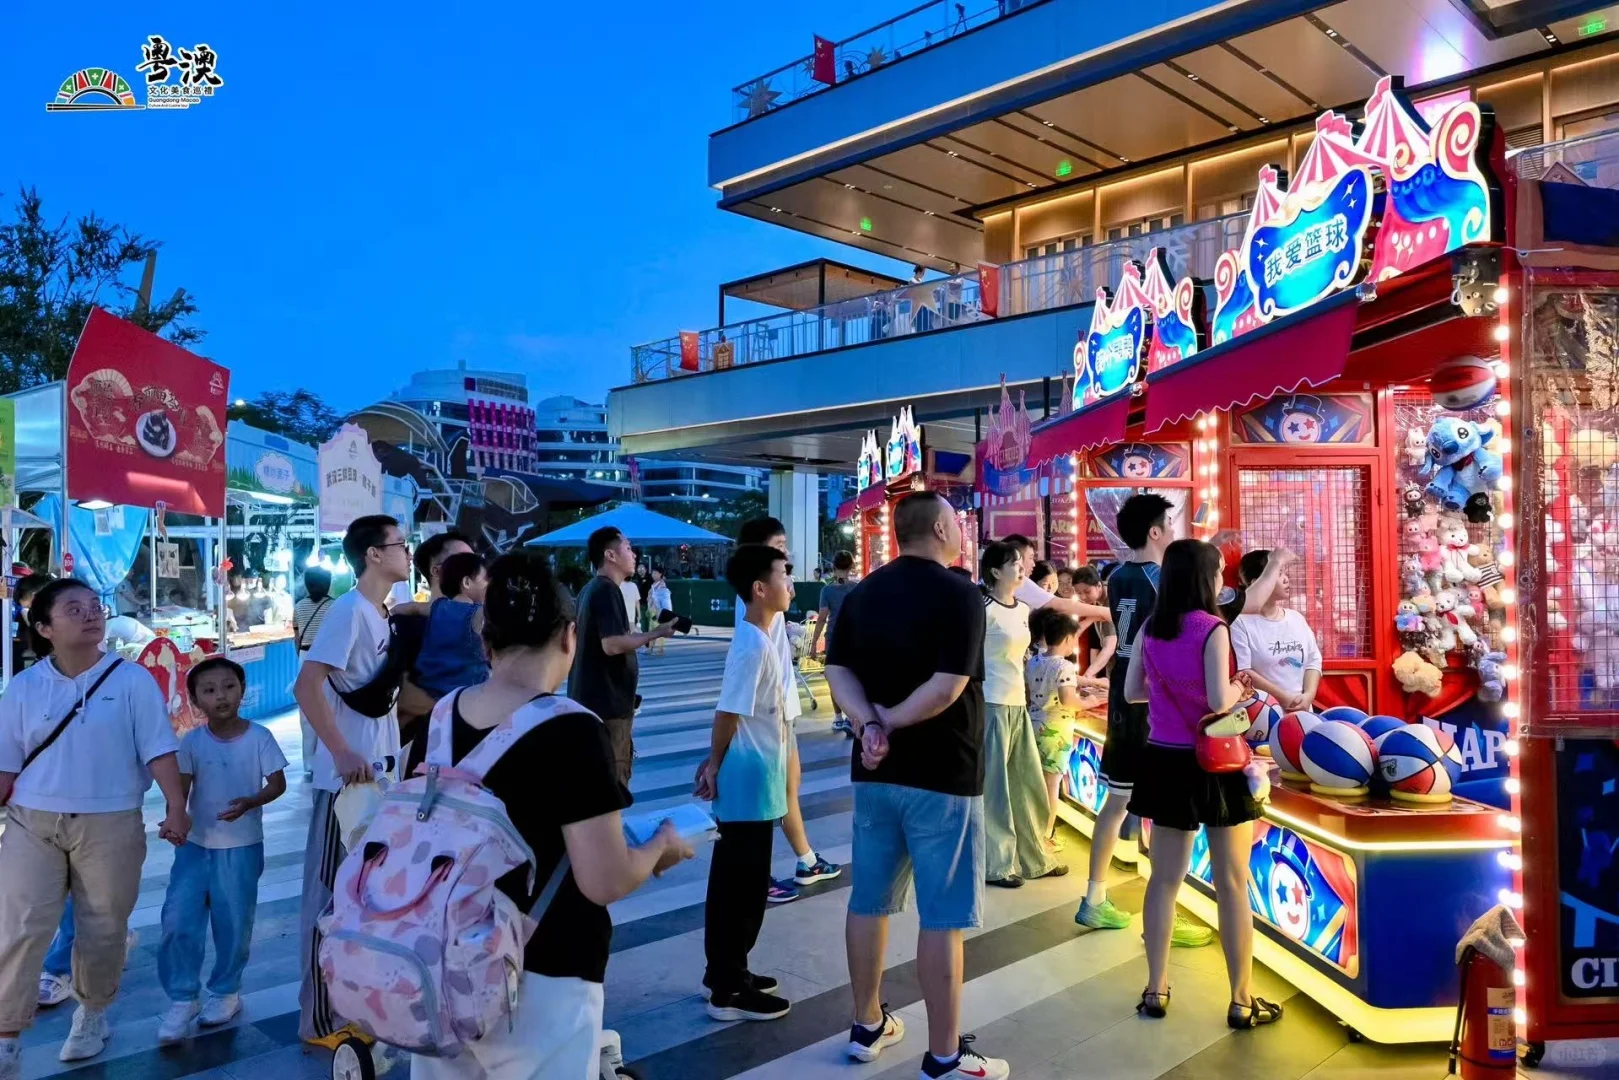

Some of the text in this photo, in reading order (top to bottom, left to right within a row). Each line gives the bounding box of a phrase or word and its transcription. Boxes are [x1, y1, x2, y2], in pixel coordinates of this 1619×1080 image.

[1265, 218, 1346, 284] 我爱篮球
[1571, 957, 1619, 989] CI
